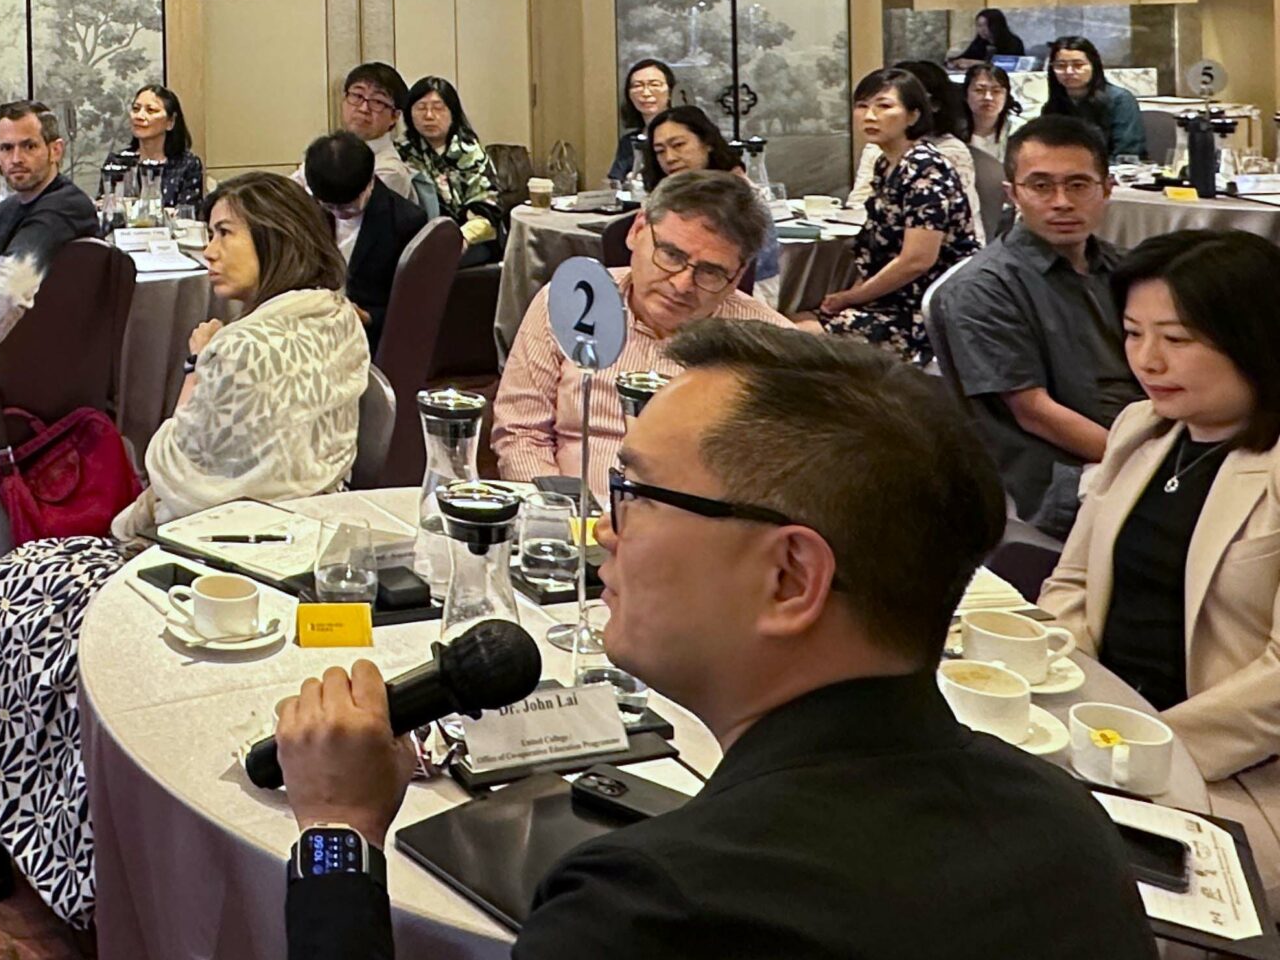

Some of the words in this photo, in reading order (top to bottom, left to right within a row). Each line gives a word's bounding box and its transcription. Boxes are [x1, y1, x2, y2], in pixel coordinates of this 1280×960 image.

[1201, 66, 1214, 85] 5
[573, 280, 595, 336] 2
[499, 705, 520, 717] Dr.
[523, 697, 554, 713] John
[556, 691, 579, 708] Lai
[549, 742, 582, 754] Education
